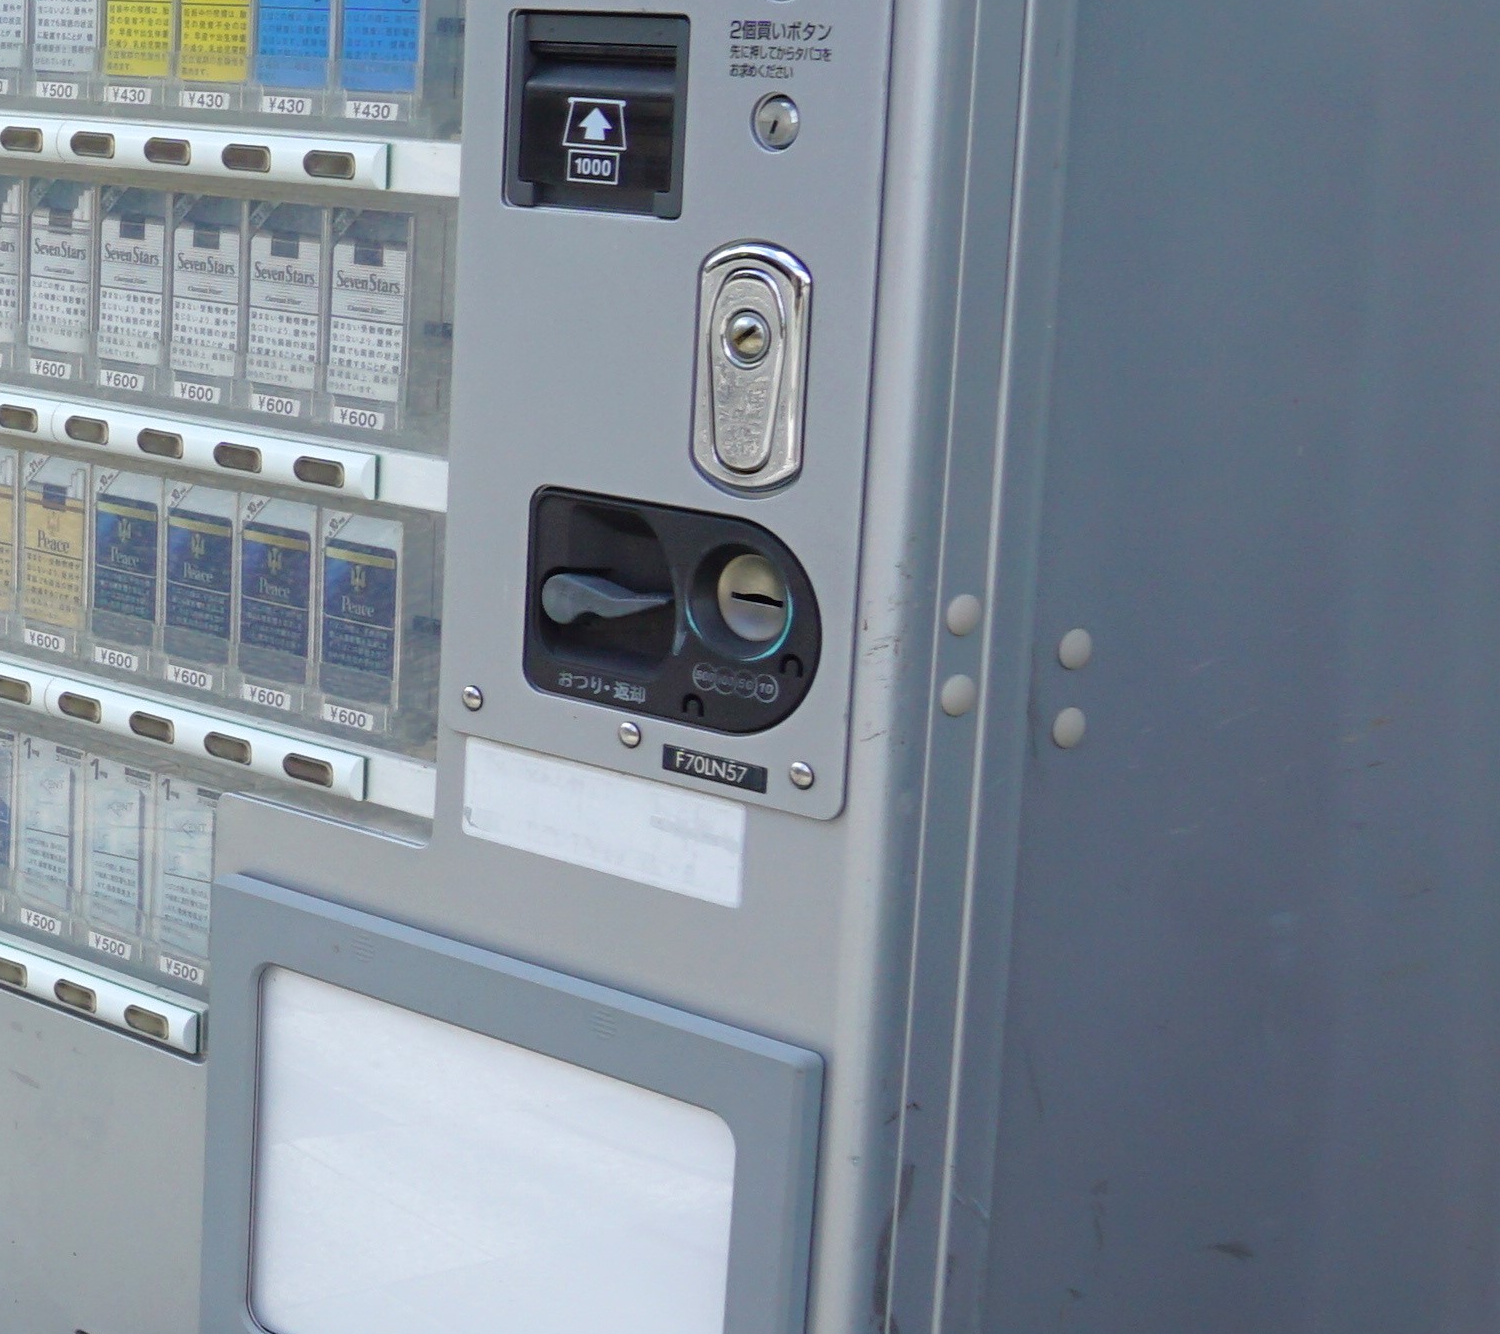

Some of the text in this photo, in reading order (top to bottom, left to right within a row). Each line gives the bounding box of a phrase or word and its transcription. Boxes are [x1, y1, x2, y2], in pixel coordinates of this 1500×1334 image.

[729, 19, 833, 42] 2個買いボタン
[729, 45, 832, 63] 先に押してからタバコを
[729, 64, 794, 79] お求めください
[42, 83, 73, 98] ¥500
[112, 87, 146, 103] ¥430
[188, 92, 224, 108] ¥430
[269, 98, 305, 115] ¥430
[353, 103, 391, 120] ¥430
[574, 156, 612, 178] 1000
[35, 360, 66, 378] ¥600
[106, 371, 138, 389] ¥600
[180, 383, 214, 402] ¥600
[259, 396, 294, 414] ¥600
[340, 408, 377, 428] ¥600
[37, 529, 70, 554] Peace
[110, 546, 140, 568] Peace
[184, 562, 213, 584] Peace
[259, 576, 291, 599] Peace
[341, 595, 375, 618] Peace
[30, 631, 60, 651] ¥600
[101, 650, 132, 669] ¥600
[173, 668, 207, 688] ¥600
[558, 670, 647, 706] おつり・返却
[250, 686, 285, 708] ¥600
[758, 681, 776, 697] 10
[330, 706, 367, 729] ¥600
[675, 751, 748, 785] F70LN57
[25, 910, 56, 933] ¥500
[94, 933, 126, 957] ¥500
[165, 958, 199, 982] ¥500
